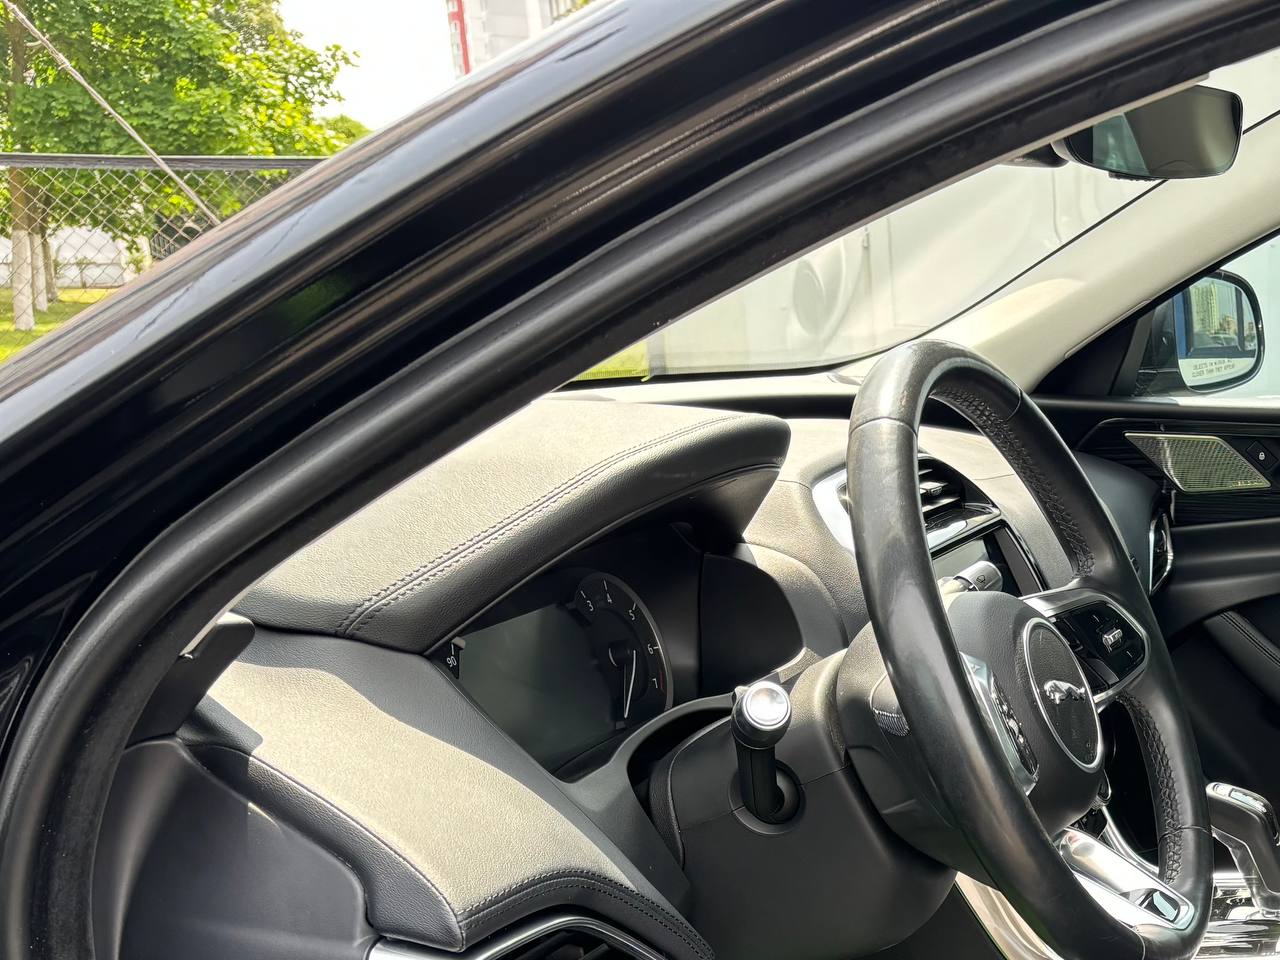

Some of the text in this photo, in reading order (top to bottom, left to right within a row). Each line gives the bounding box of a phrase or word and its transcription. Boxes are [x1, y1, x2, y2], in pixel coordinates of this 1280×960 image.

[586, 600, 594, 612] 3
[628, 609, 636, 621] 5
[647, 643, 654, 655] 6
[446, 655, 457, 668] 90
[652, 678, 659, 689] 7
